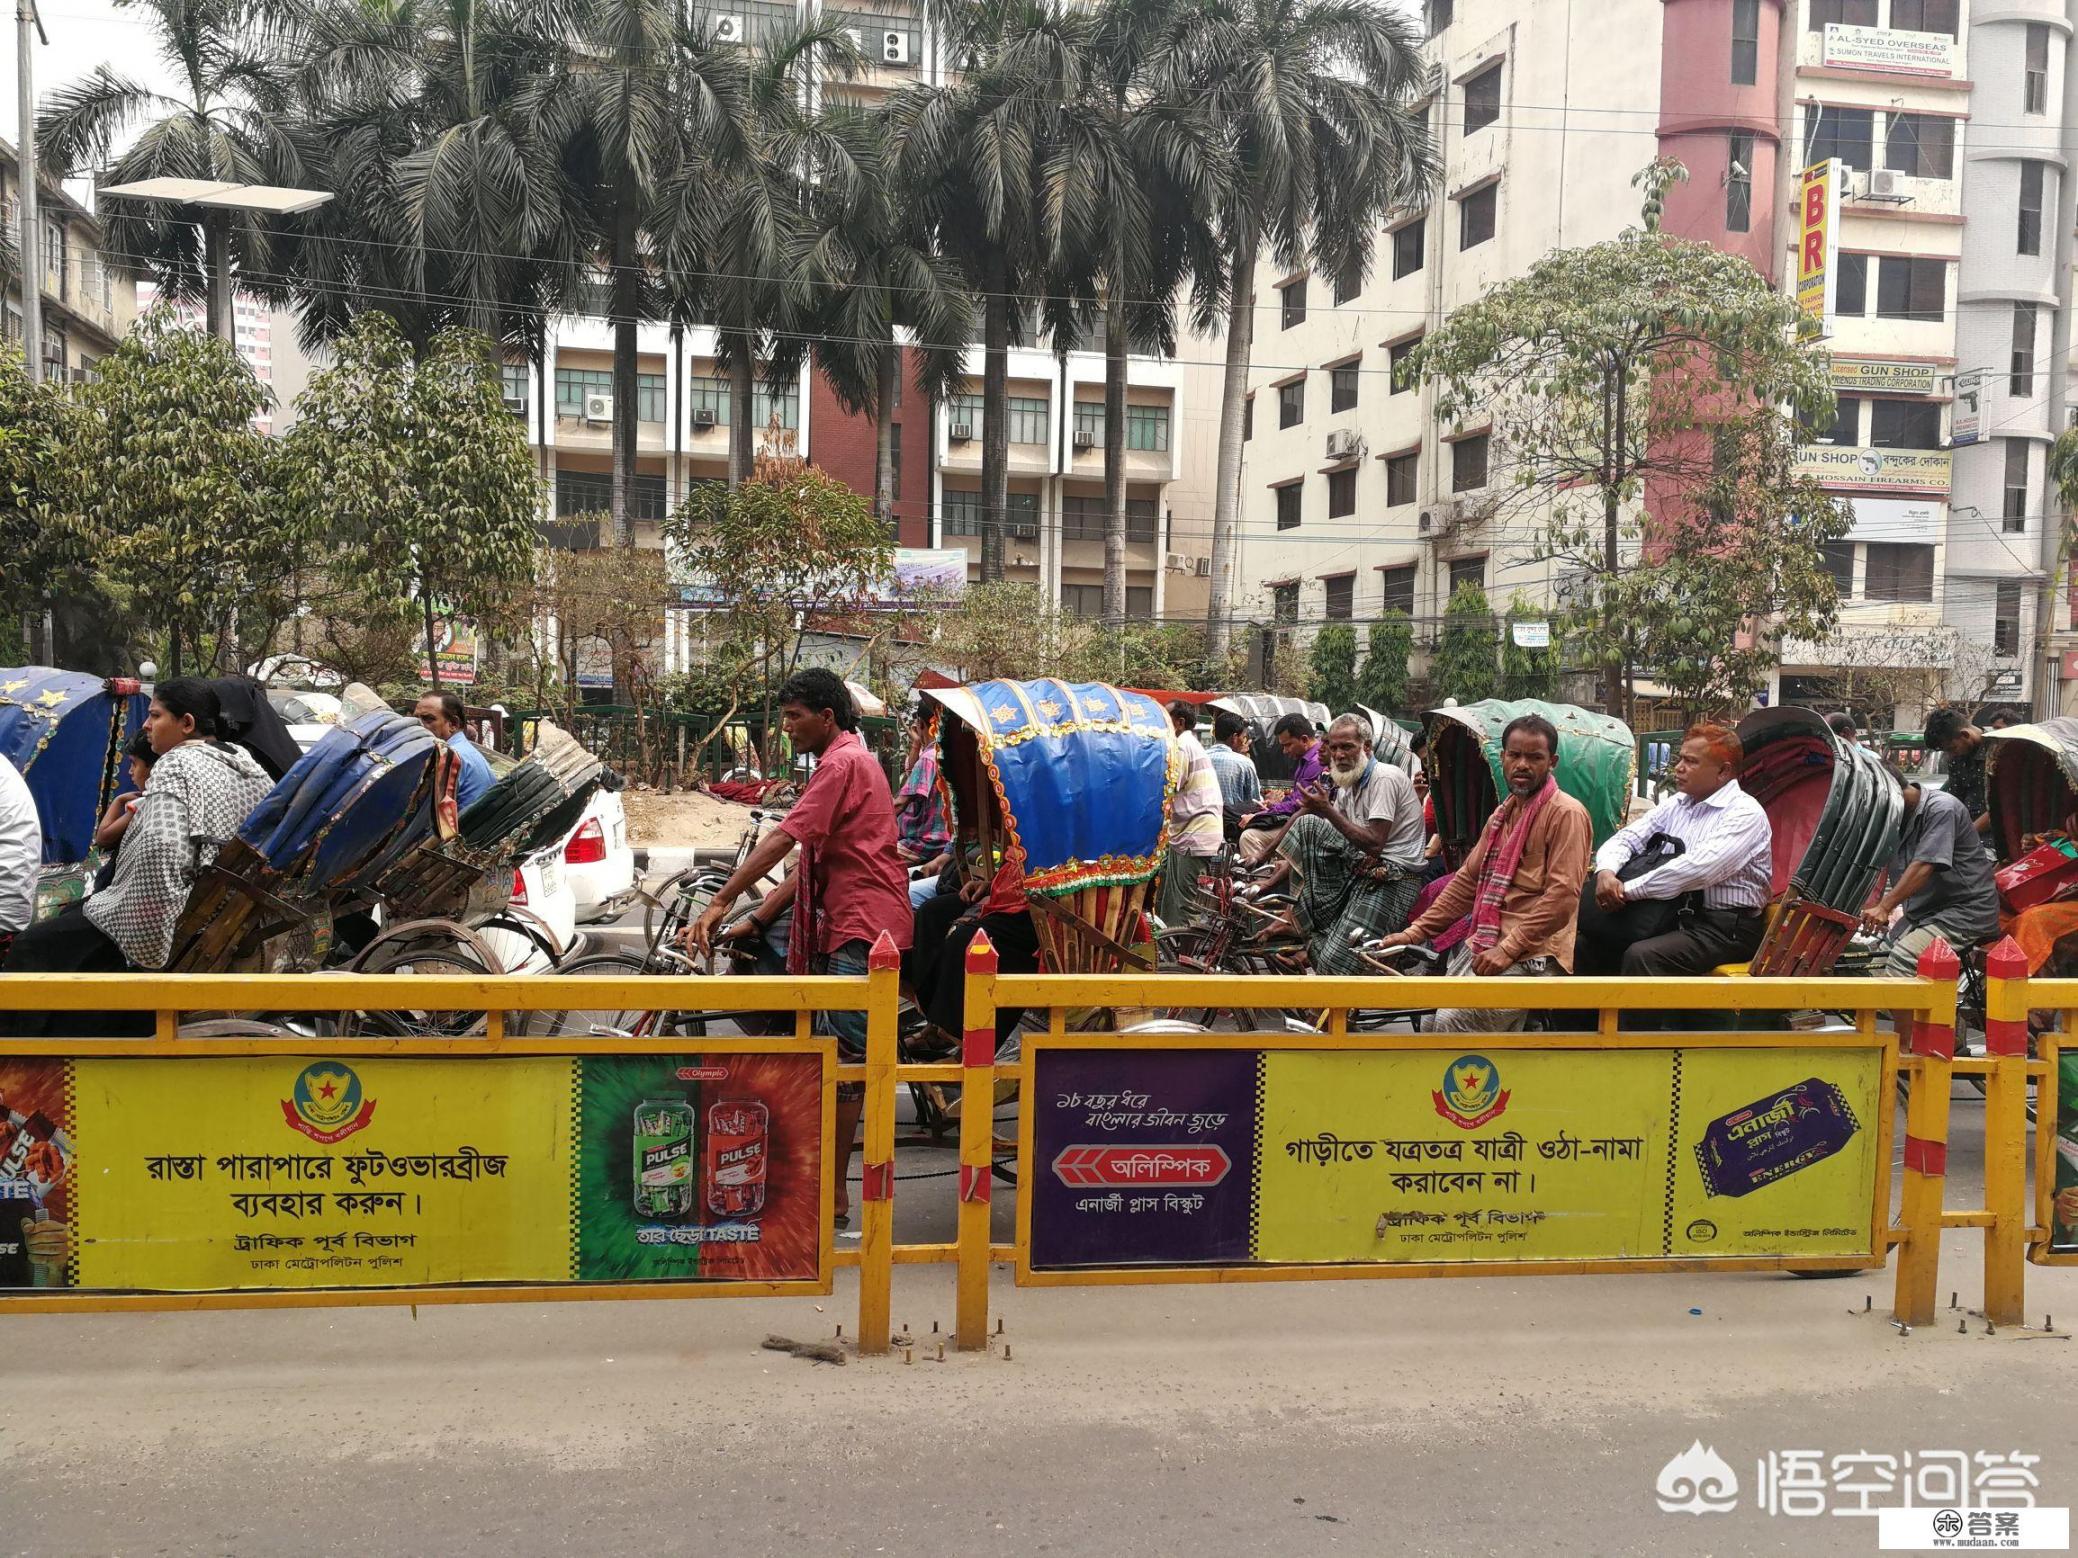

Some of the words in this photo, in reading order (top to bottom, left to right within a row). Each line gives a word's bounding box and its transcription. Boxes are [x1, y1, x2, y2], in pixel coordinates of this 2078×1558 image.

[1836, 35, 1885, 46] AL-SYED
[1887, 37, 1947, 52] OVERSEAS
[1864, 50, 1895, 60] TRAVELS
[1896, 53, 1951, 65] INTERNATIONAL
[1860, 365, 1889, 376] GUN
[1892, 367, 1929, 377] SHOP
[1859, 376, 1886, 387] TRADING
[1886, 376, 1931, 389] CORPORATION
[1821, 453, 1858, 464] SHOP
[1085, 1111, 1145, 1131] বাংলার
[1142, 1108, 1190, 1127] জীবন
[646, 1142, 687, 1166] PULSE
[720, 1142, 761, 1165] PULSE
[1285, 1132, 1378, 1167] গাড়ীতে
[1383, 1137, 1466, 1162] যত্রতত্র
[1471, 1131, 1528, 1162] যাত্রী
[1536, 1130, 1645, 1162] ওঠা-নামা
[144, 1152, 207, 1181] রাস্তা
[215, 1152, 335, 1182] পারাপারে
[341, 1146, 509, 1185] ফুটওভারব্রীজ
[1110, 1153, 1212, 1179] অলিম্পিক
[1389, 1170, 1486, 1194] করাবেন
[1491, 1169, 1521, 1194] না
[230, 1191, 327, 1219] ব্যবহার
[331, 1191, 407, 1218] করুন
[1453, 1209, 1483, 1228] পূর্ব
[233, 1231, 305, 1252] ট্রাফিক
[311, 1231, 346, 1253] পূর্ব
[353, 1230, 417, 1250] বিভাগ
[705, 1224, 760, 1242] TASTE
[1400, 1233, 1425, 1243] ঢাকা
[1428, 1231, 1493, 1243] মেট্রোপলিটন
[1497, 1231, 1528, 1244] পুলিশ
[250, 1258, 279, 1271] ঢাকা
[284, 1256, 363, 1272] মেট্রোপলিটন
[366, 1255, 404, 1271] পুলিশ
